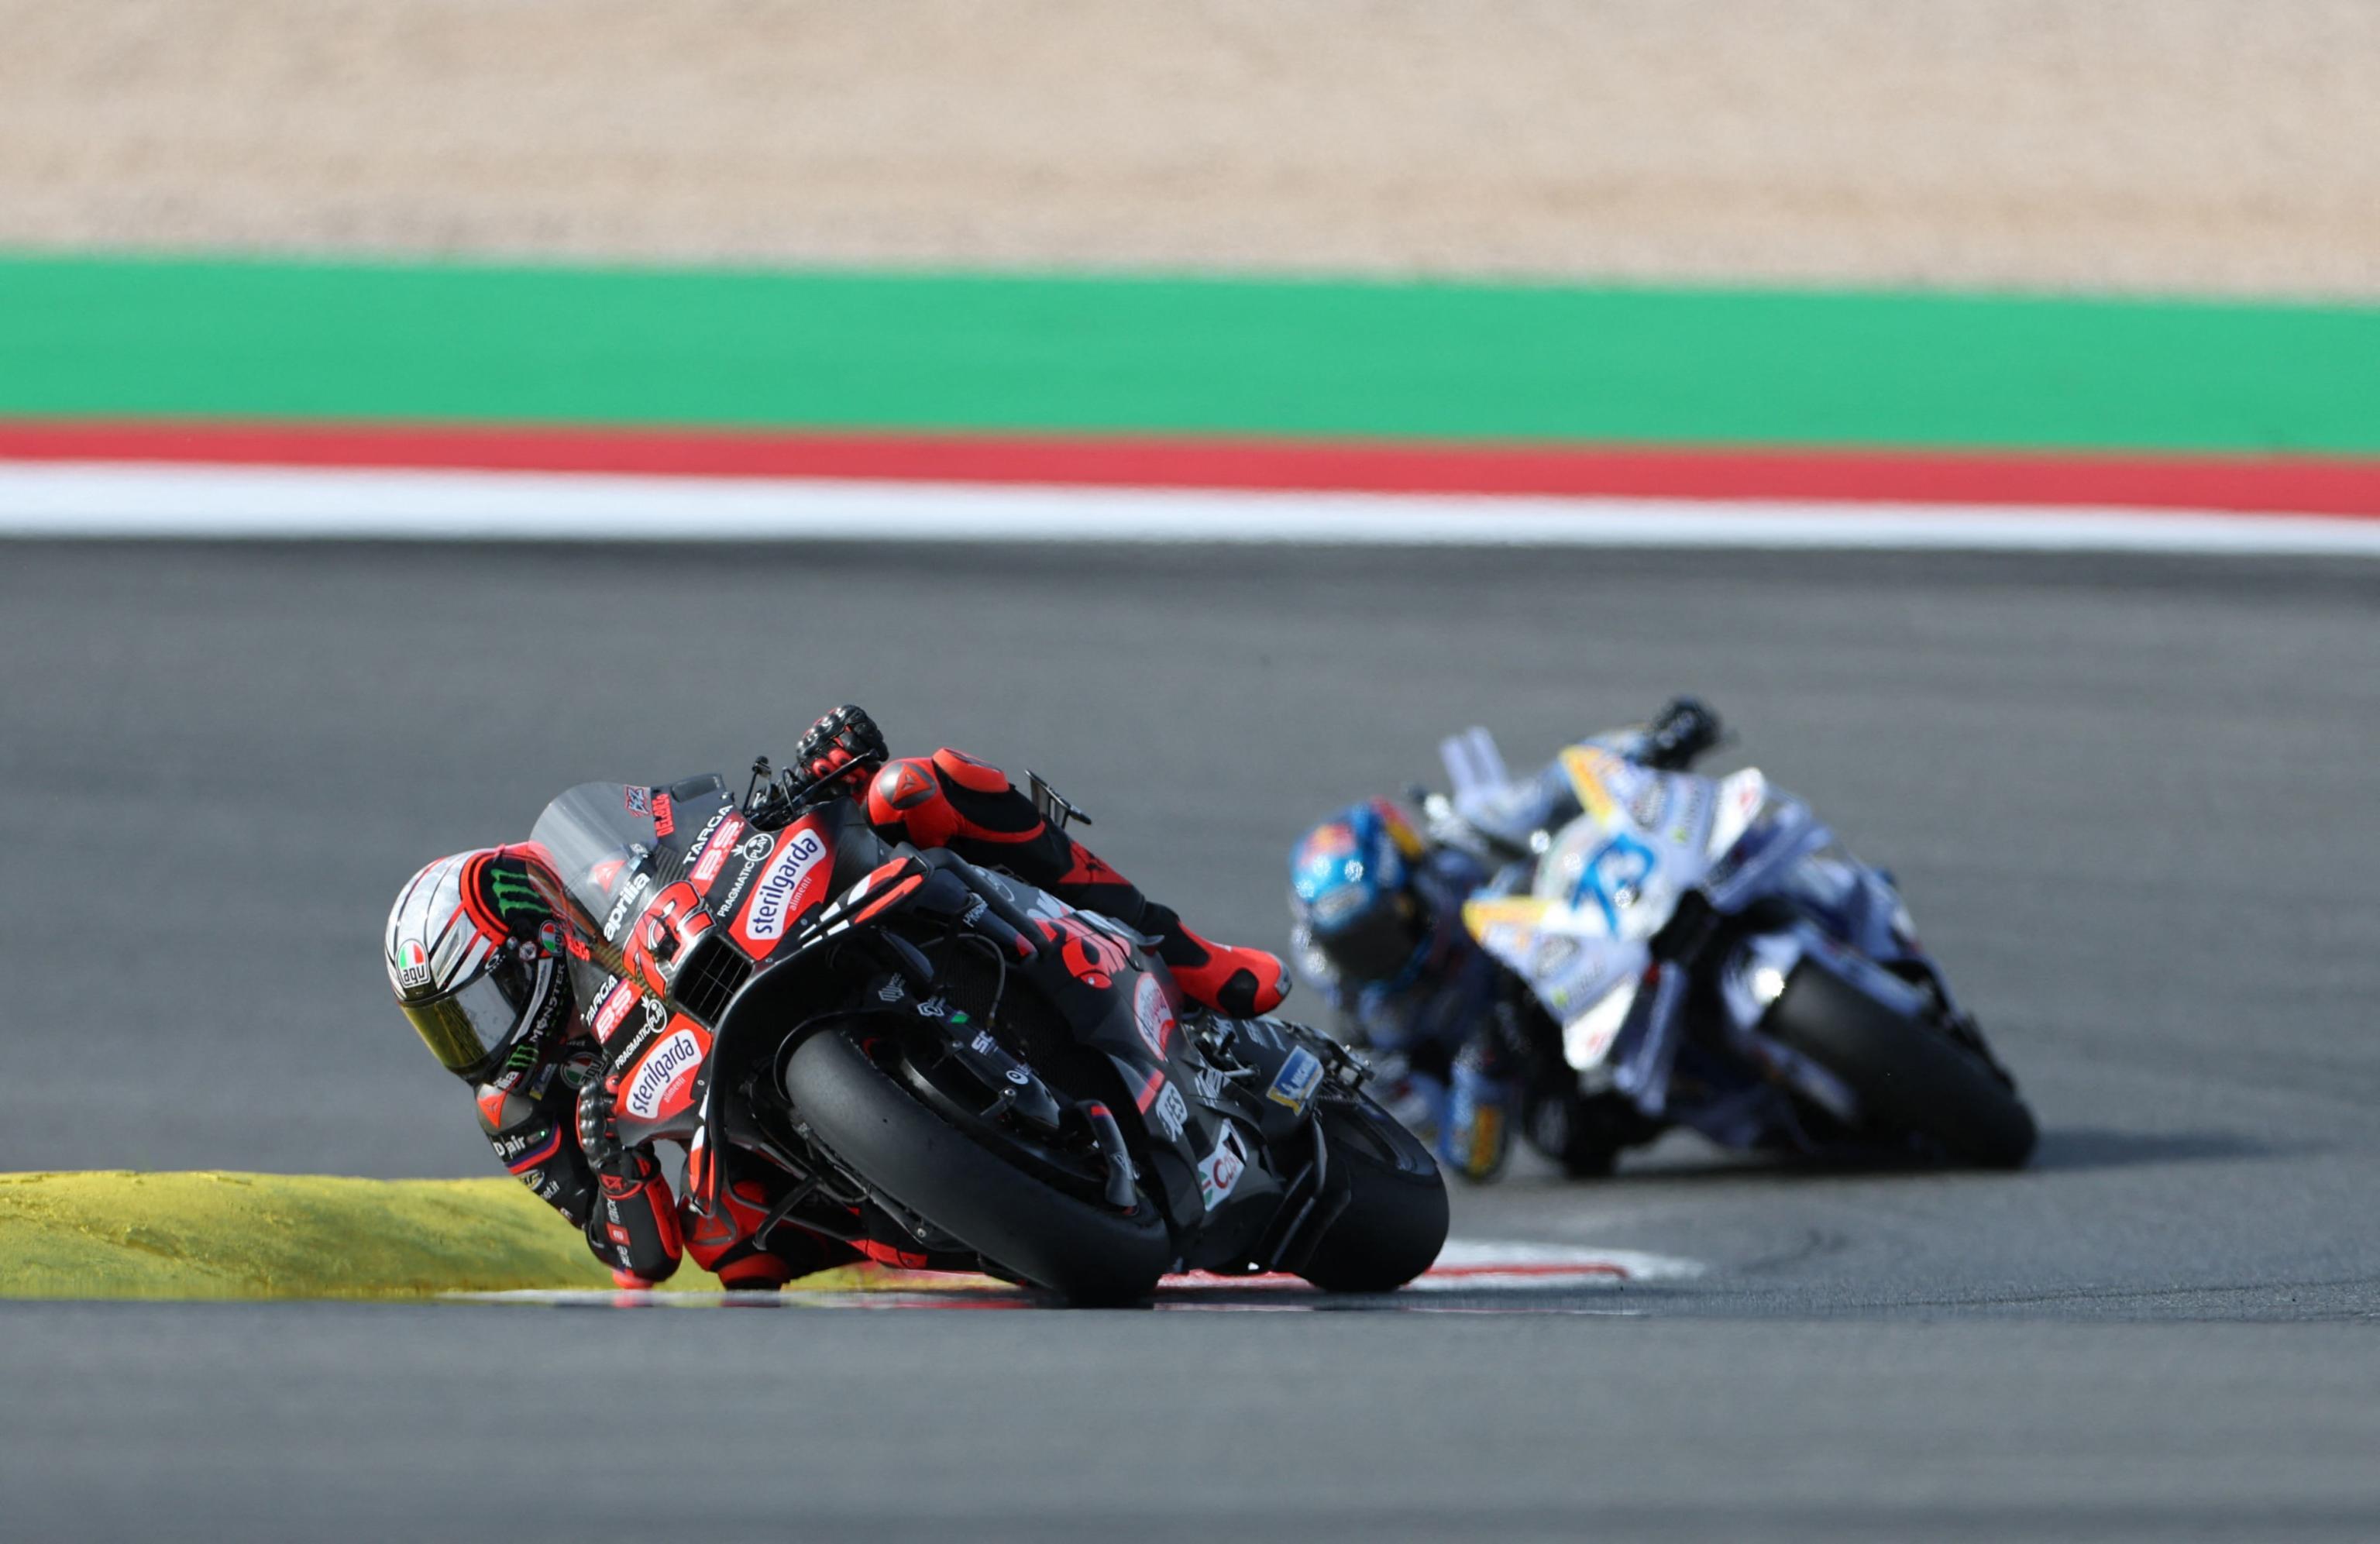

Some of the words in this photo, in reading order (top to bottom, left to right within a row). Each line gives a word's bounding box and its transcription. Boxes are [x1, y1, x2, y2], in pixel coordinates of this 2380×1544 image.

[683, 804, 734, 865] TARGA
[693, 818, 740, 880] BS
[604, 872, 651, 942] aprilia
[717, 861, 755, 917] PRAGMATIC
[750, 836, 769, 859] PLAY
[752, 837, 819, 934] sterilgarda
[789, 877, 813, 912] alimenti
[402, 967, 426, 985] agv
[528, 964, 566, 1042] MONSTER
[586, 975, 618, 1026] TARGA
[595, 982, 632, 1040] BS
[614, 1023, 652, 1070] PRAGMATIC
[648, 1007, 665, 1026] PLAY
[632, 1036, 695, 1113] sterilgarda
[663, 1075, 686, 1103] alimenti
